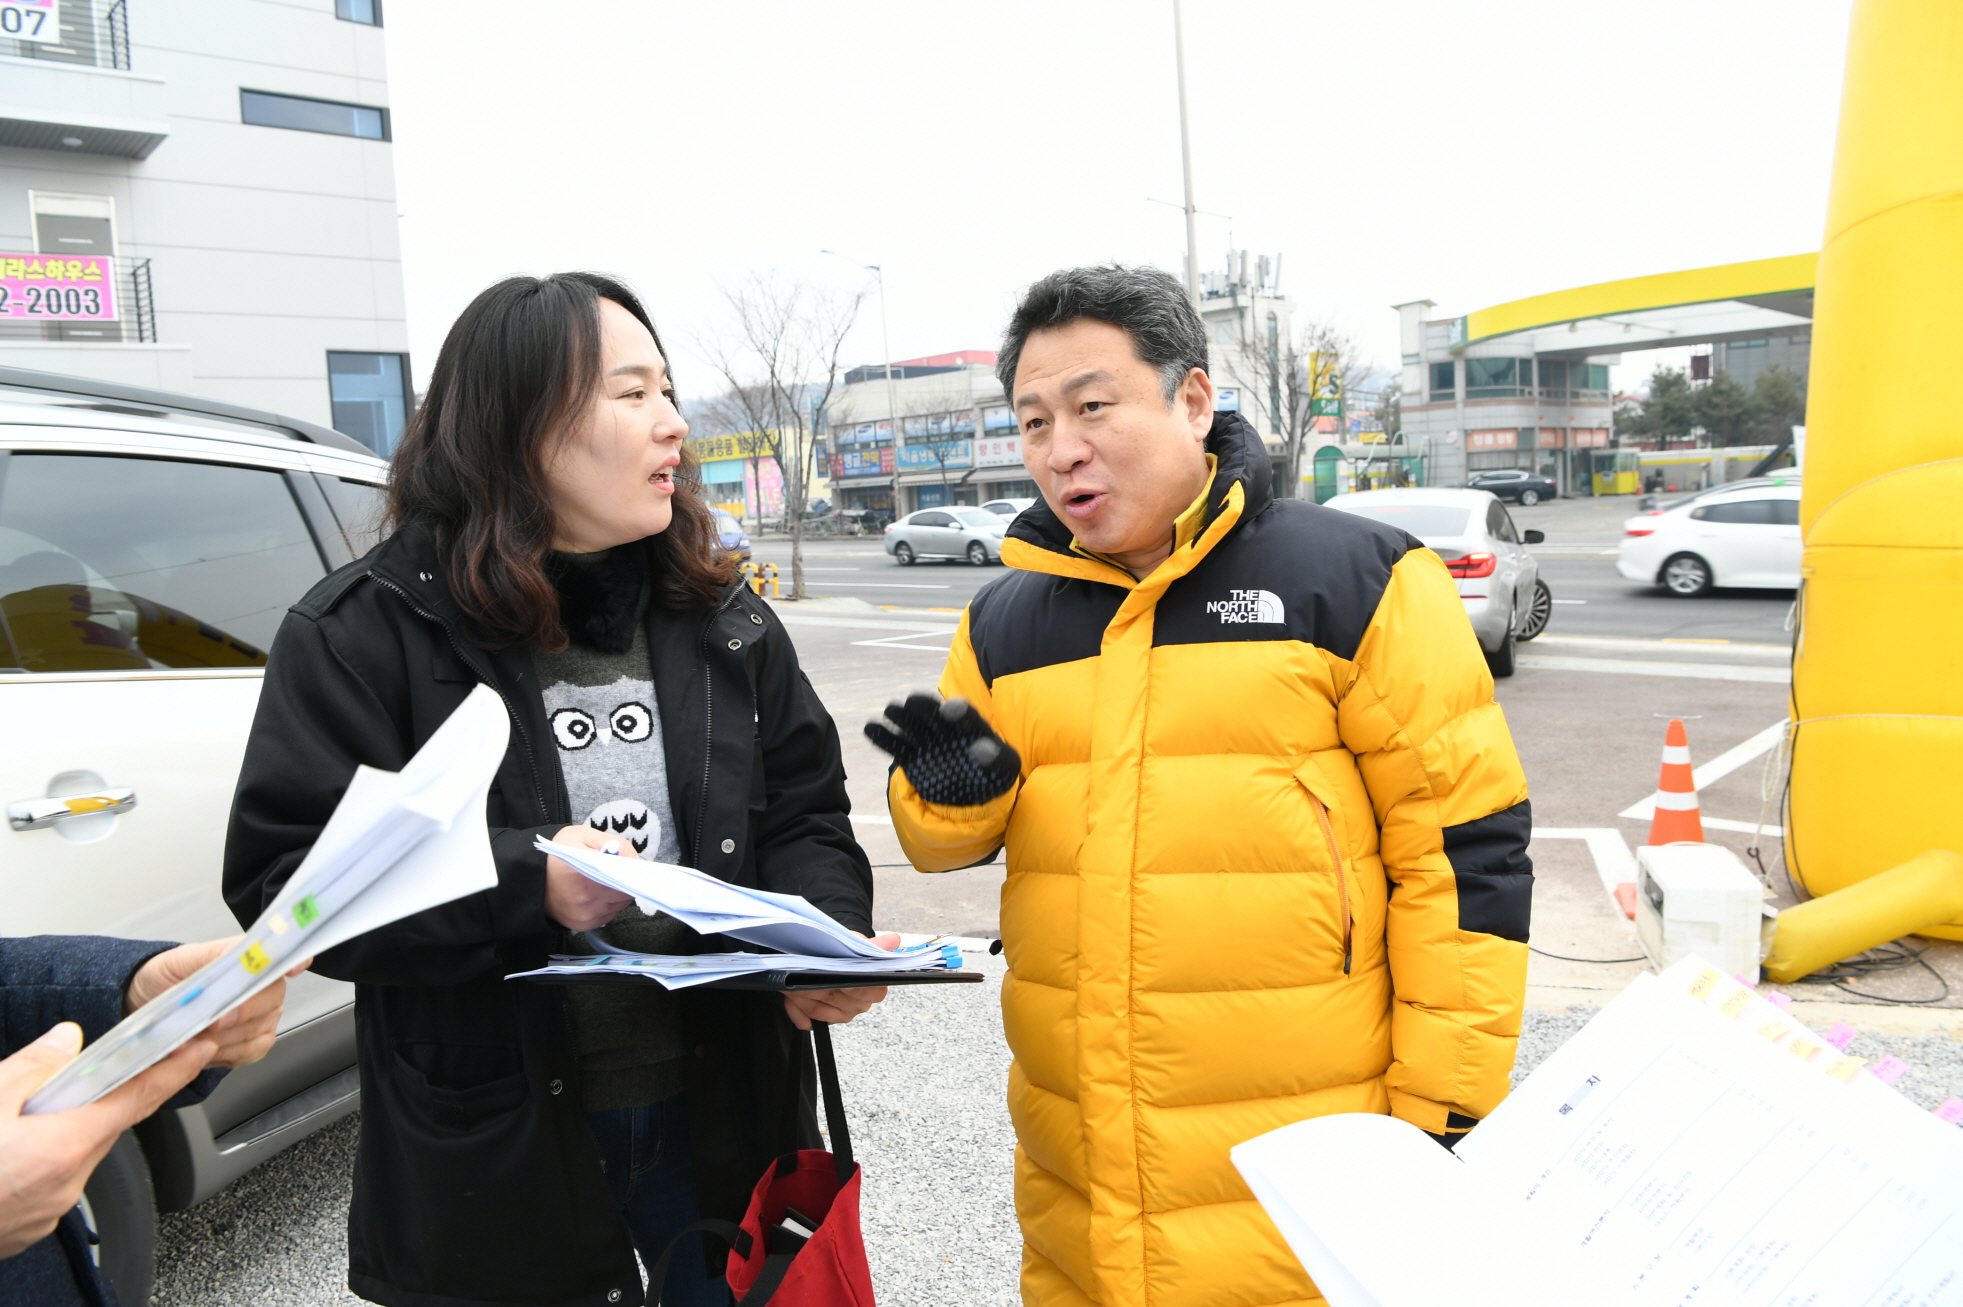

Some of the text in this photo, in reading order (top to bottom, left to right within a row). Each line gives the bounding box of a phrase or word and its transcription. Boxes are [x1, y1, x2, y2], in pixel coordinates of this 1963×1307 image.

[1, 7, 47, 36] 07
[1230, 590, 1259, 601] THE
[1206, 600, 1258, 613] NORTH
[1220, 612, 1258, 624] FACE
